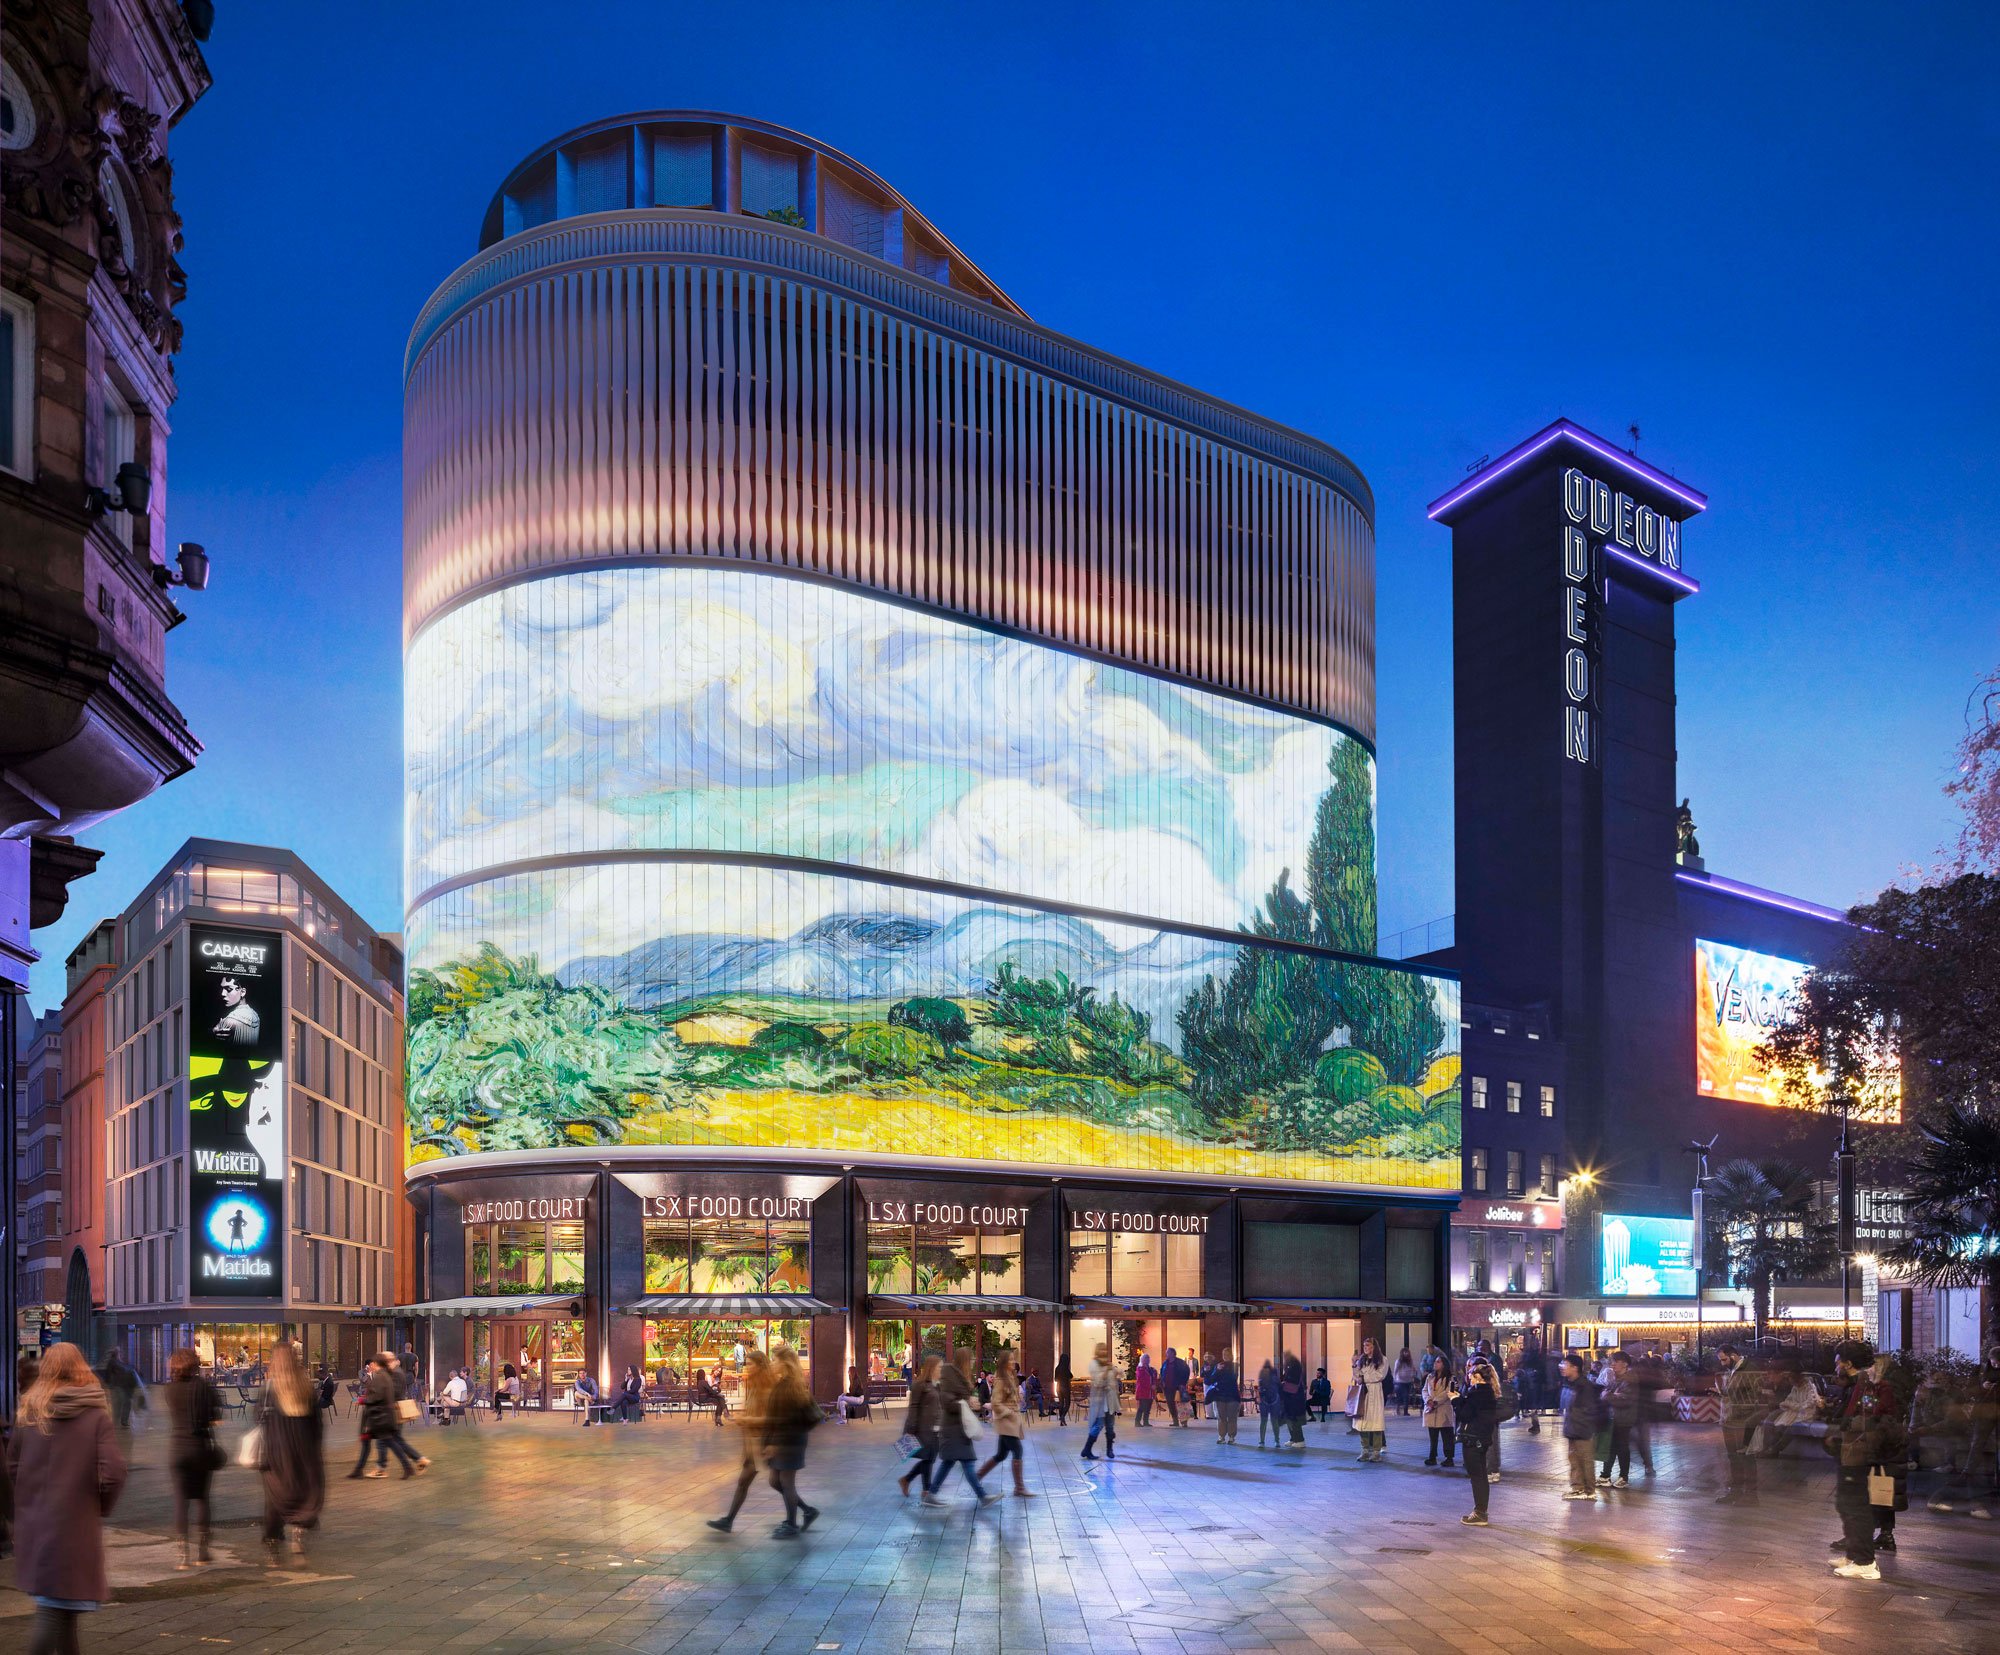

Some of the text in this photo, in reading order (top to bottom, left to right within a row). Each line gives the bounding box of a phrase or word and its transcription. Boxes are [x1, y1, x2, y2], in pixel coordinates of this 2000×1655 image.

[1564, 467, 1680, 570] ODEON
[202, 942, 266, 961] CABARET
[461, 1198, 585, 1223] LSX FOOD COURT
[643, 1197, 814, 1218] LSX FOOD COURT
[870, 1201, 1029, 1226] LSX FOOD COURT
[1485, 1206, 1523, 1221] Jollibee
[1074, 1211, 1208, 1233] LSX FOOD COURT
[203, 1256, 272, 1276] Matilda
[1489, 1308, 1526, 1323] Jollibee
[1659, 1311, 1695, 1319] BOOK NOW
